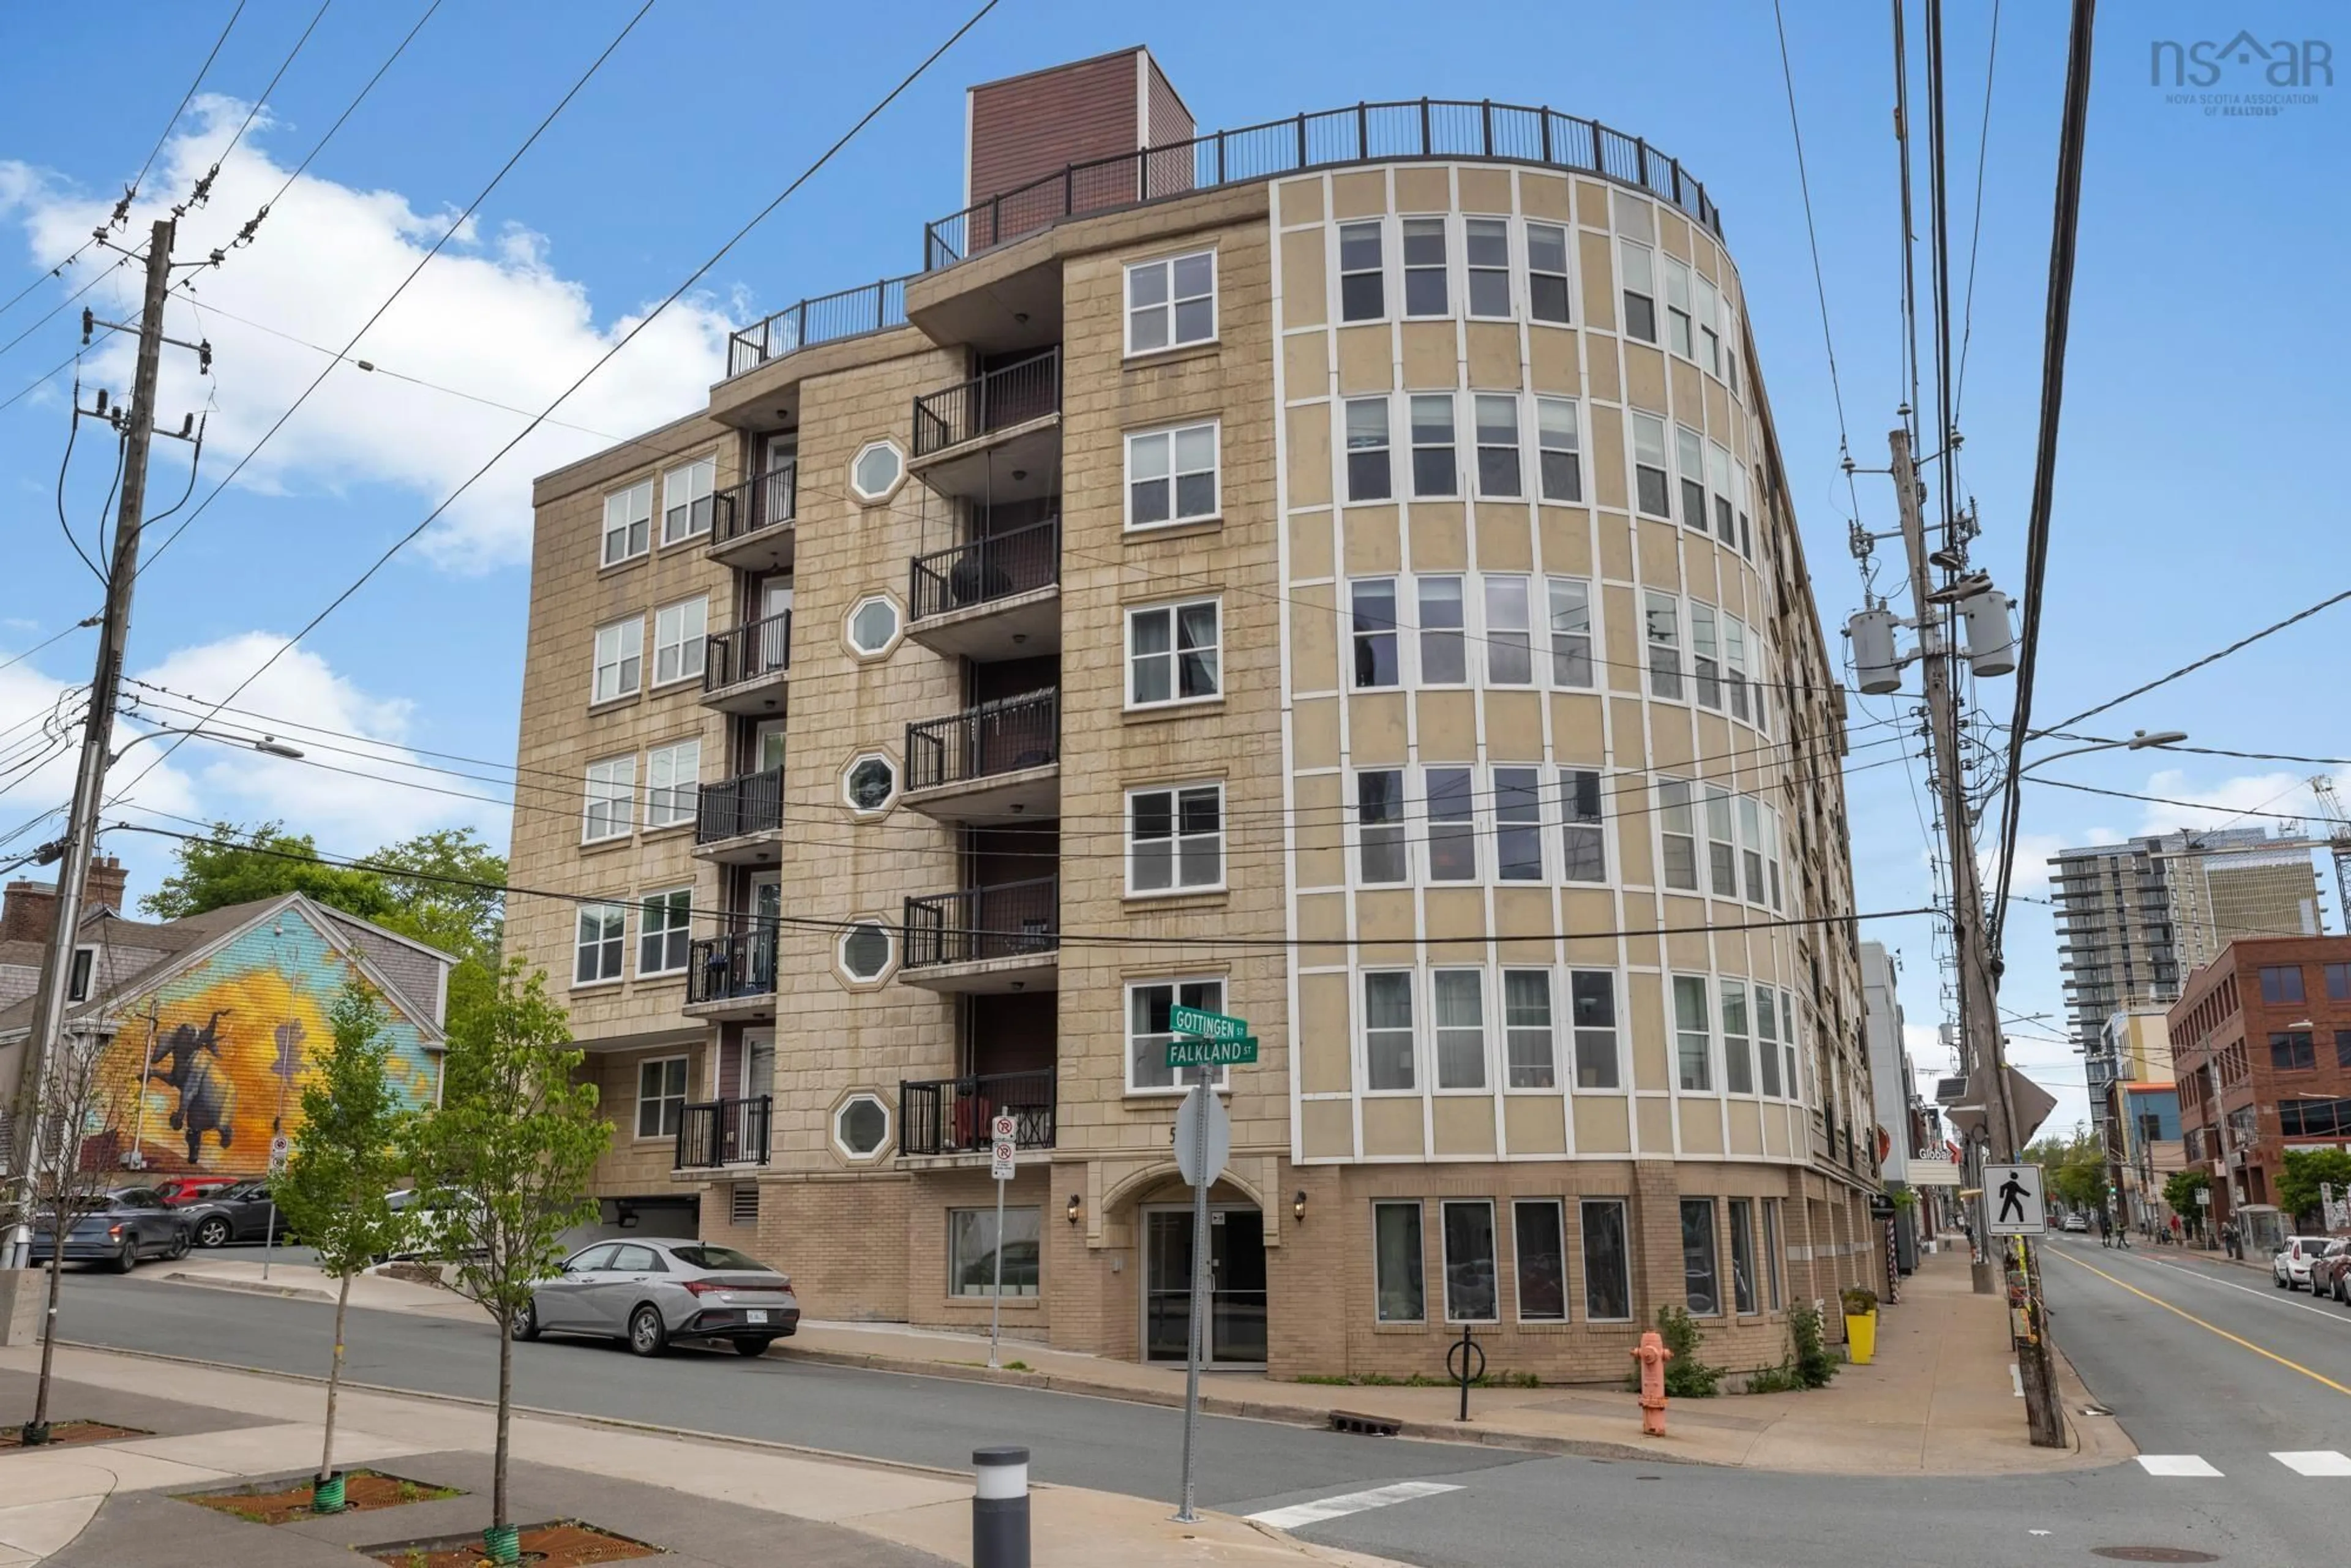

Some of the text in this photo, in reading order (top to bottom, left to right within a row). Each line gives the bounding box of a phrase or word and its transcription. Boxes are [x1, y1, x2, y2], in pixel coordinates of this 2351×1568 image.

[1176, 1010, 1243, 1038] GOTTINGEN ST
[1170, 1042, 1251, 1063] FALKLAND ST
[1919, 1148, 1951, 1159] Globa
